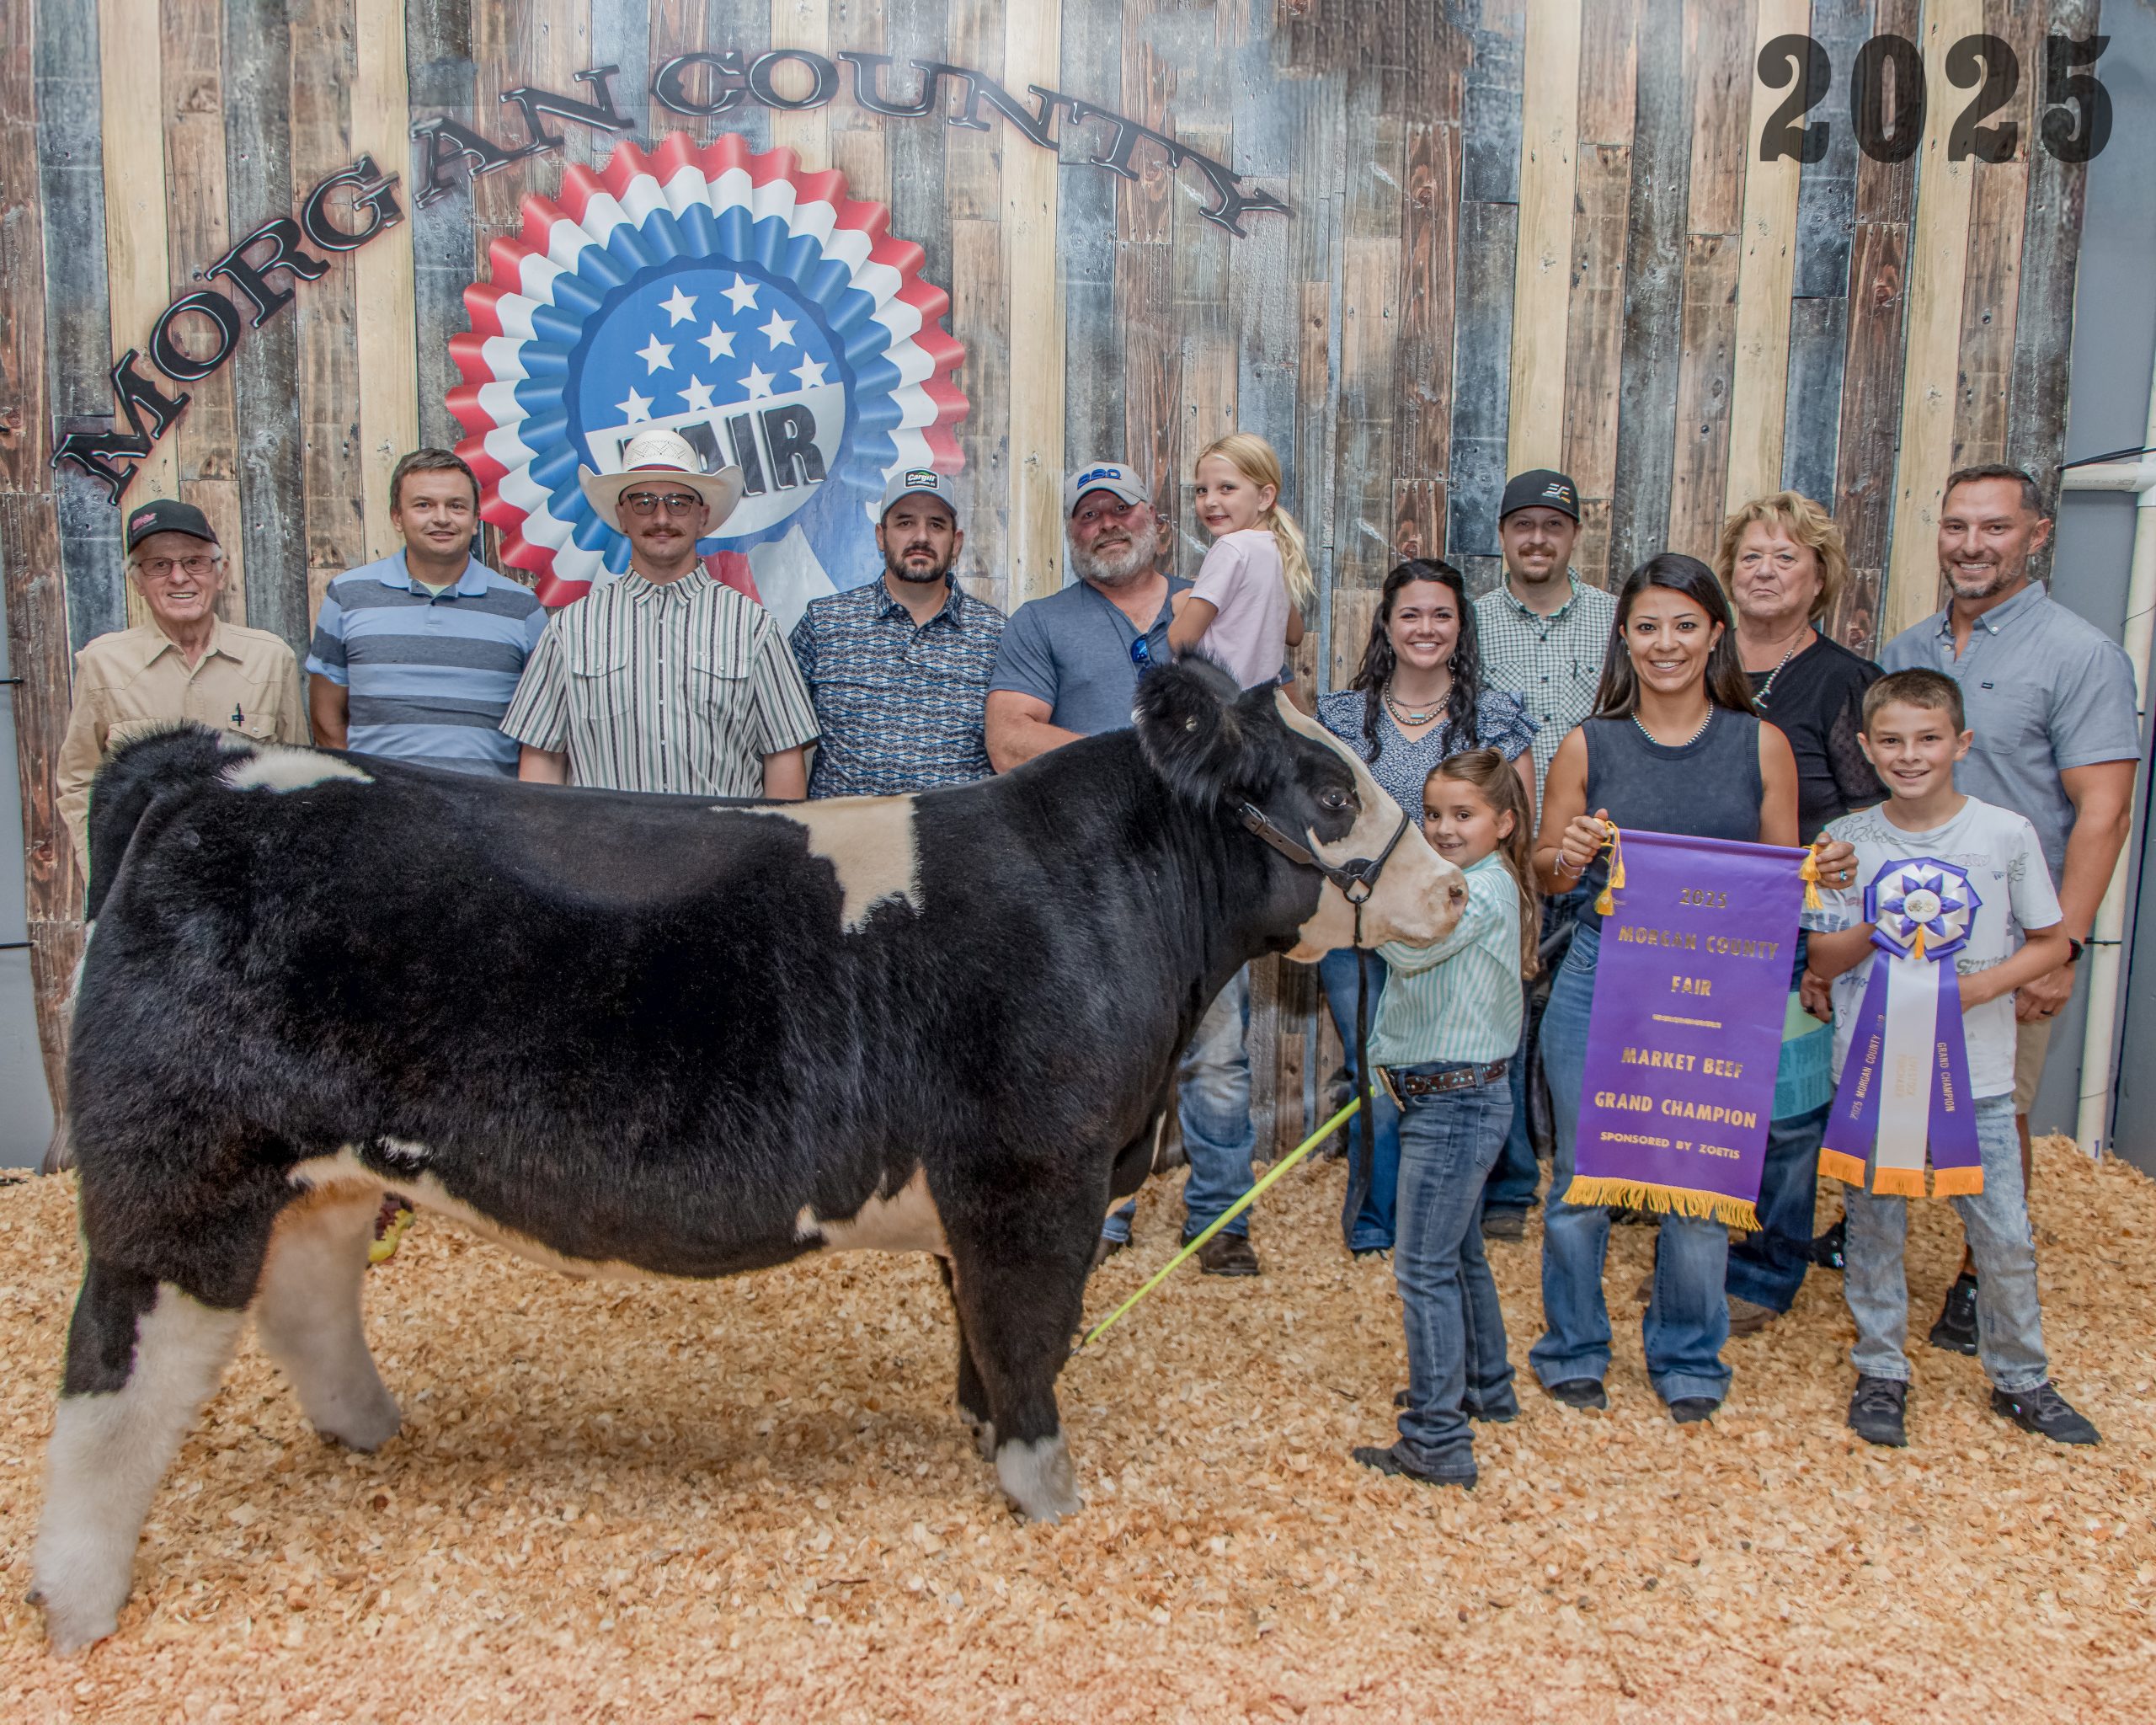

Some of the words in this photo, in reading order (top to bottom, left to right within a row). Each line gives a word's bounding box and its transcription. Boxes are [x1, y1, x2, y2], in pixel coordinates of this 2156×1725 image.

[49, 64, 635, 506] MORGAN
[651, 50, 1295, 239] COUNTY
[617, 403, 828, 498] AIR
[1678, 888, 1726, 908] 2025
[1618, 925, 1697, 950] MORGAN
[1706, 935, 1780, 959] COUNTY
[1671, 975, 1711, 996] FAIR
[1621, 1047, 1695, 1071] MARKET
[1703, 1058, 1743, 1078] BEEF
[1937, 1042, 1949, 1068] GRAND
[1849, 1100, 1863, 1120] 2025
[1856, 1066, 1872, 1098] MORGAN
[1865, 1034, 1881, 1065] COUNTY
[1940, 1071, 1955, 1112] CHAMPION
[1594, 1091, 1652, 1112] GRAND
[1661, 1098, 1757, 1129] CHAMPION
[1600, 1131, 1670, 1148] SPONSORED
[1675, 1140, 1693, 1151] BY
[1699, 1144, 1741, 1159] ZOETIS
